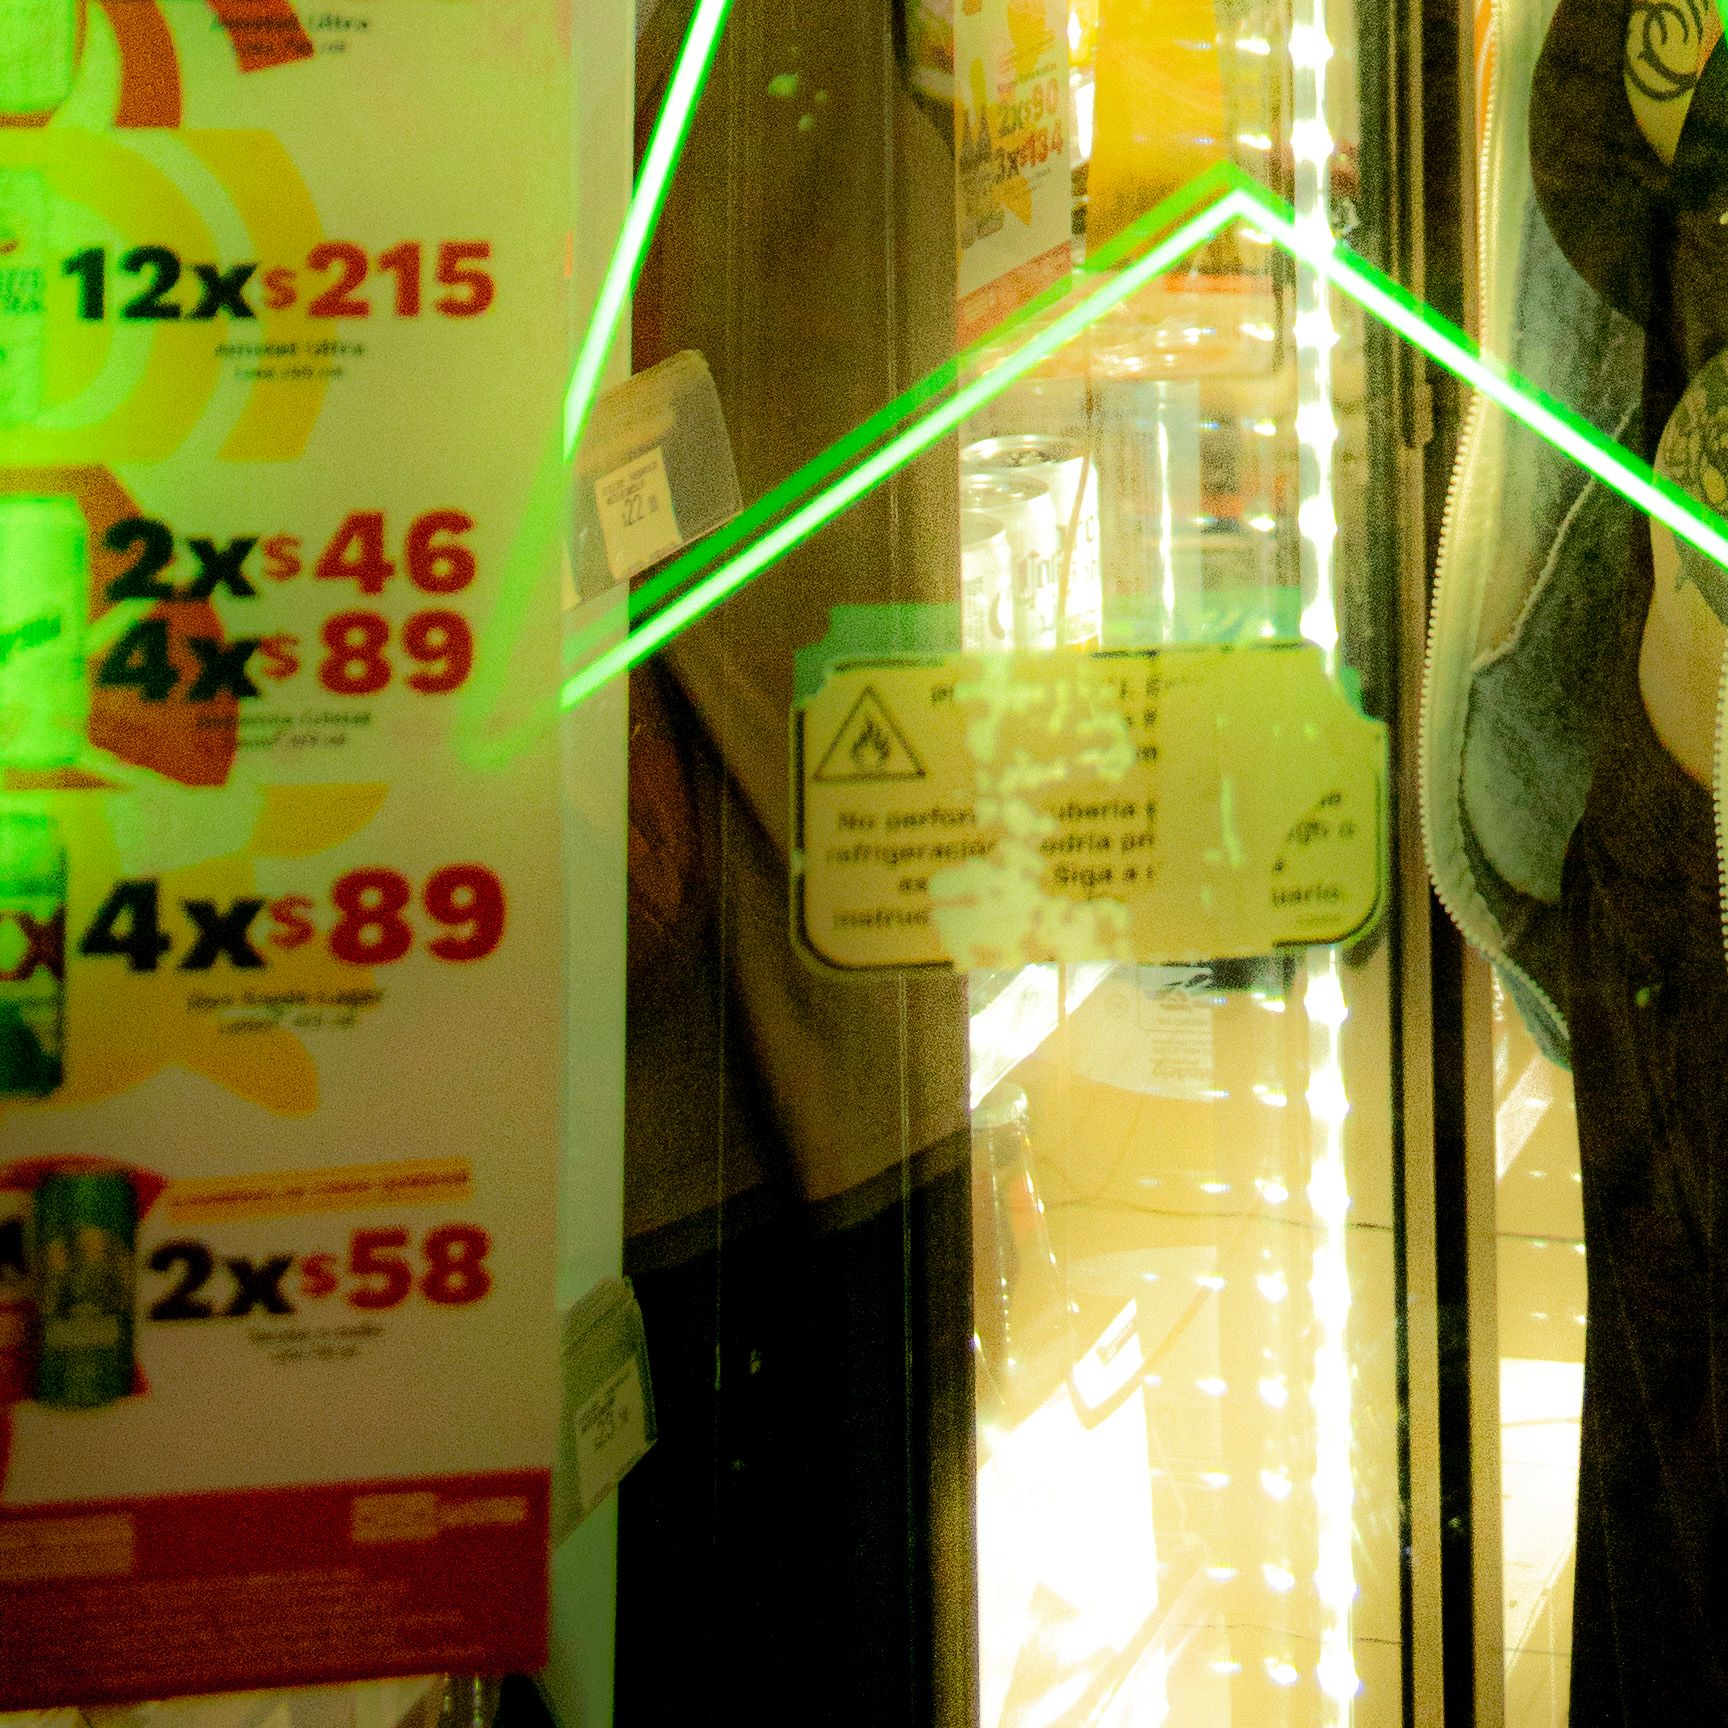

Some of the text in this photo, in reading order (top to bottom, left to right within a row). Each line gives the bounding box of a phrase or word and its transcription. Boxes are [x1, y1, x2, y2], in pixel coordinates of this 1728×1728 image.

[62, 240, 496, 322] 12x$215
[103, 509, 478, 603] 2x$46
[99, 609, 474, 704] 4x$89
[80, 862, 507, 974] 4x$89
[145, 1222, 493, 1322] 2x$58
